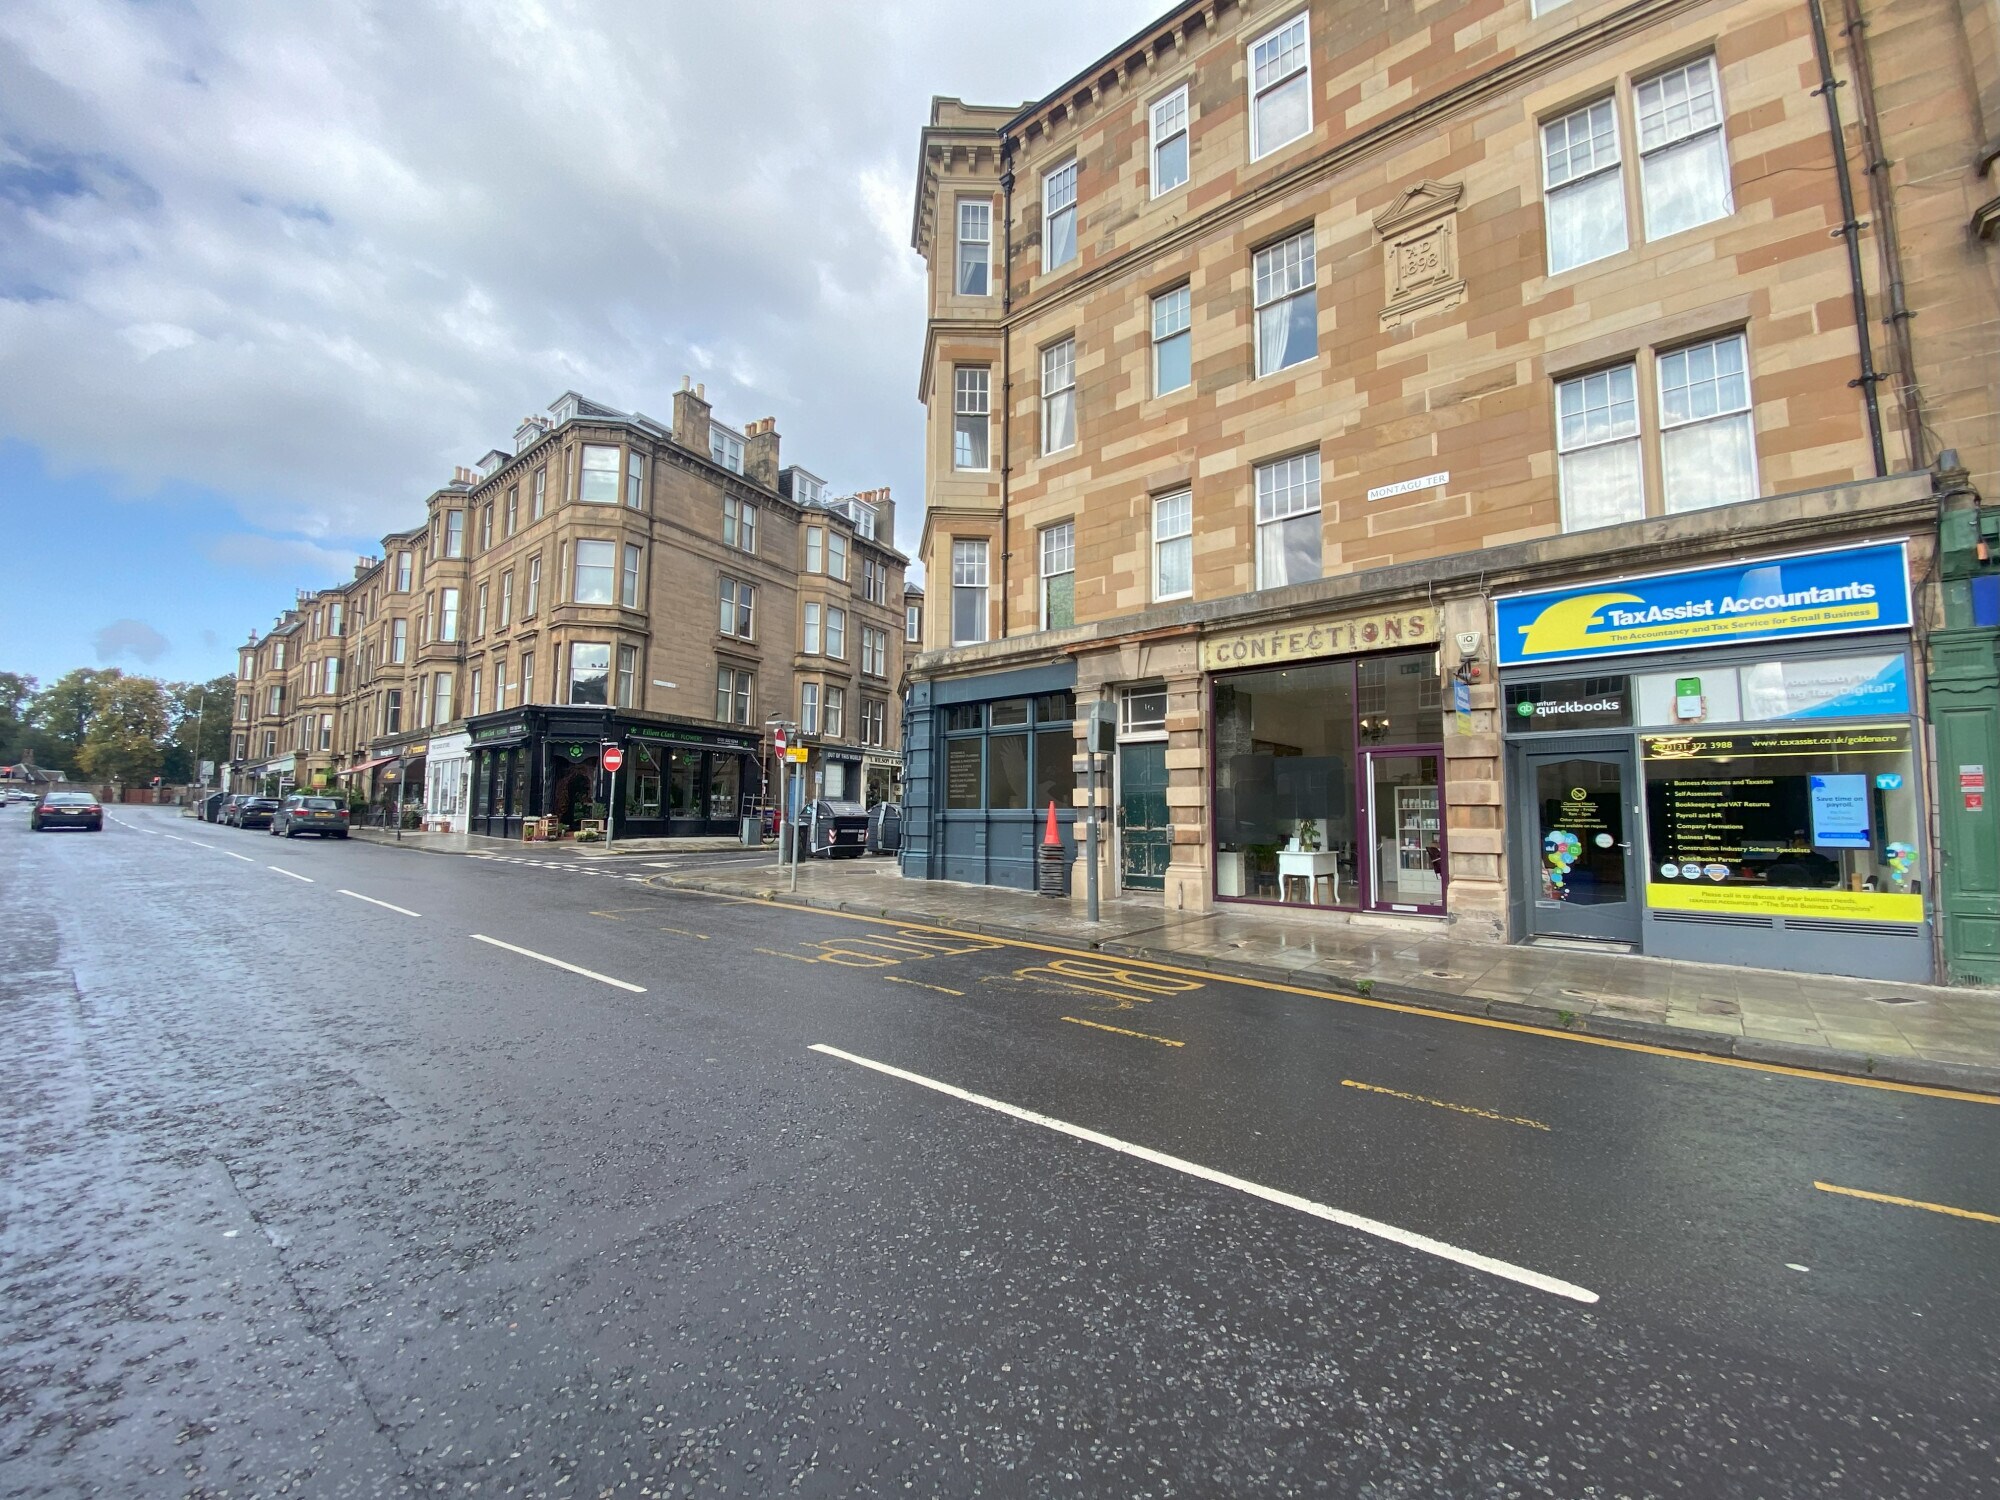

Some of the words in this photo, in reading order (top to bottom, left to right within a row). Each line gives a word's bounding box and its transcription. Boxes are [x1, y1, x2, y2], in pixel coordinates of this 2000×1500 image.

[1401, 253, 1438, 278] 1898
[1370, 480, 1421, 499] MONTAGU
[1426, 474, 1446, 486] TER
[1608, 600, 1715, 627] TaxAssist
[1719, 581, 1876, 614] Accountants
[1610, 634, 1628, 642] The
[1629, 628, 1689, 640] Accountancy
[1692, 624, 1710, 633] and
[1711, 622, 1729, 631] Tax
[1731, 618, 1770, 629] Service
[1772, 617, 1788, 626] for
[1790, 613, 1821, 624] Small
[1823, 609, 1871, 621] Business
[1216, 615, 1426, 662] CONFECTIONS
[1840, 682, 1896, 696] Digital?
[1536, 699, 1619, 717] quickbooks
[1692, 742, 1707, 750] 322
[1710, 741, 1733, 749] 3988
[1752, 735, 1897, 747] www.taxassist.co.uk/goldenacre
[1675, 801, 1715, 809] Bookkeeping
[1676, 823, 1706, 831] Company
[1720, 845, 1747, 853] Industry
